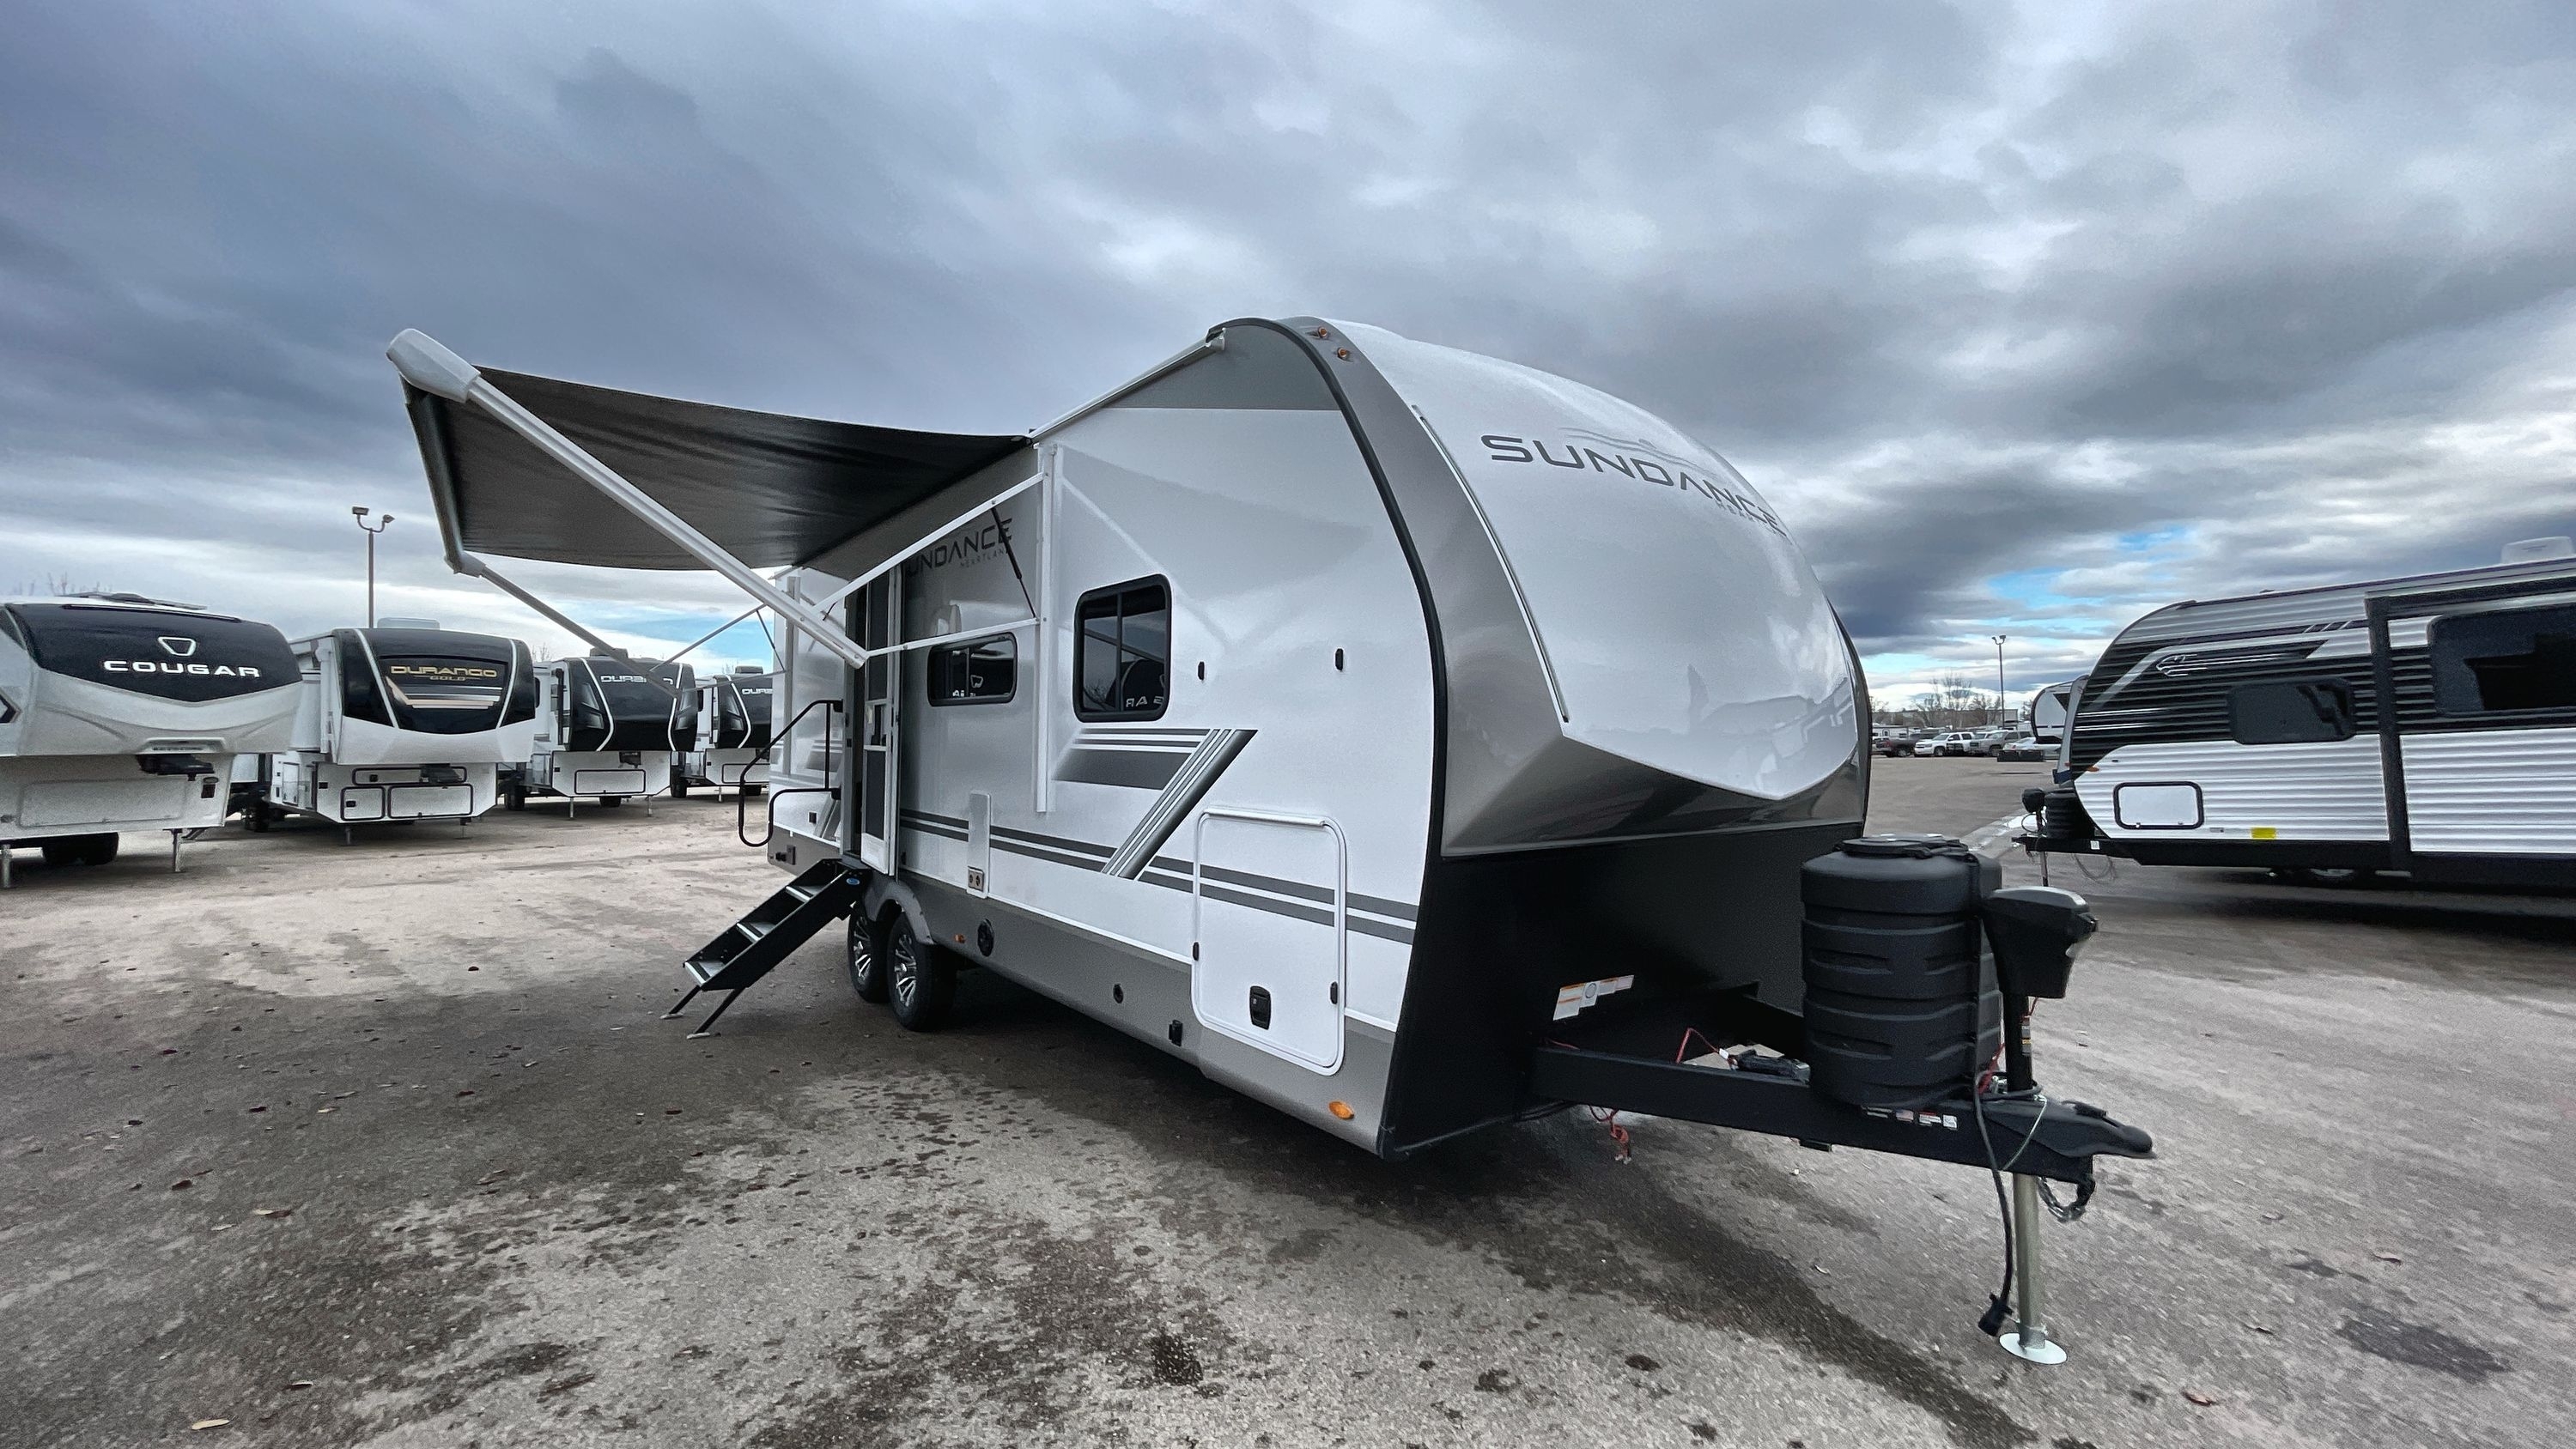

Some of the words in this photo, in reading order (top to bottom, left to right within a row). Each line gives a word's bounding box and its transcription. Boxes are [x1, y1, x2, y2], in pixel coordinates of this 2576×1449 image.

[1480, 434, 1787, 537] SUNDANCE
[906, 518, 1012, 577] UNDANCE
[103, 660, 261, 678] COUGAR
[391, 665, 497, 677] DURANGO
